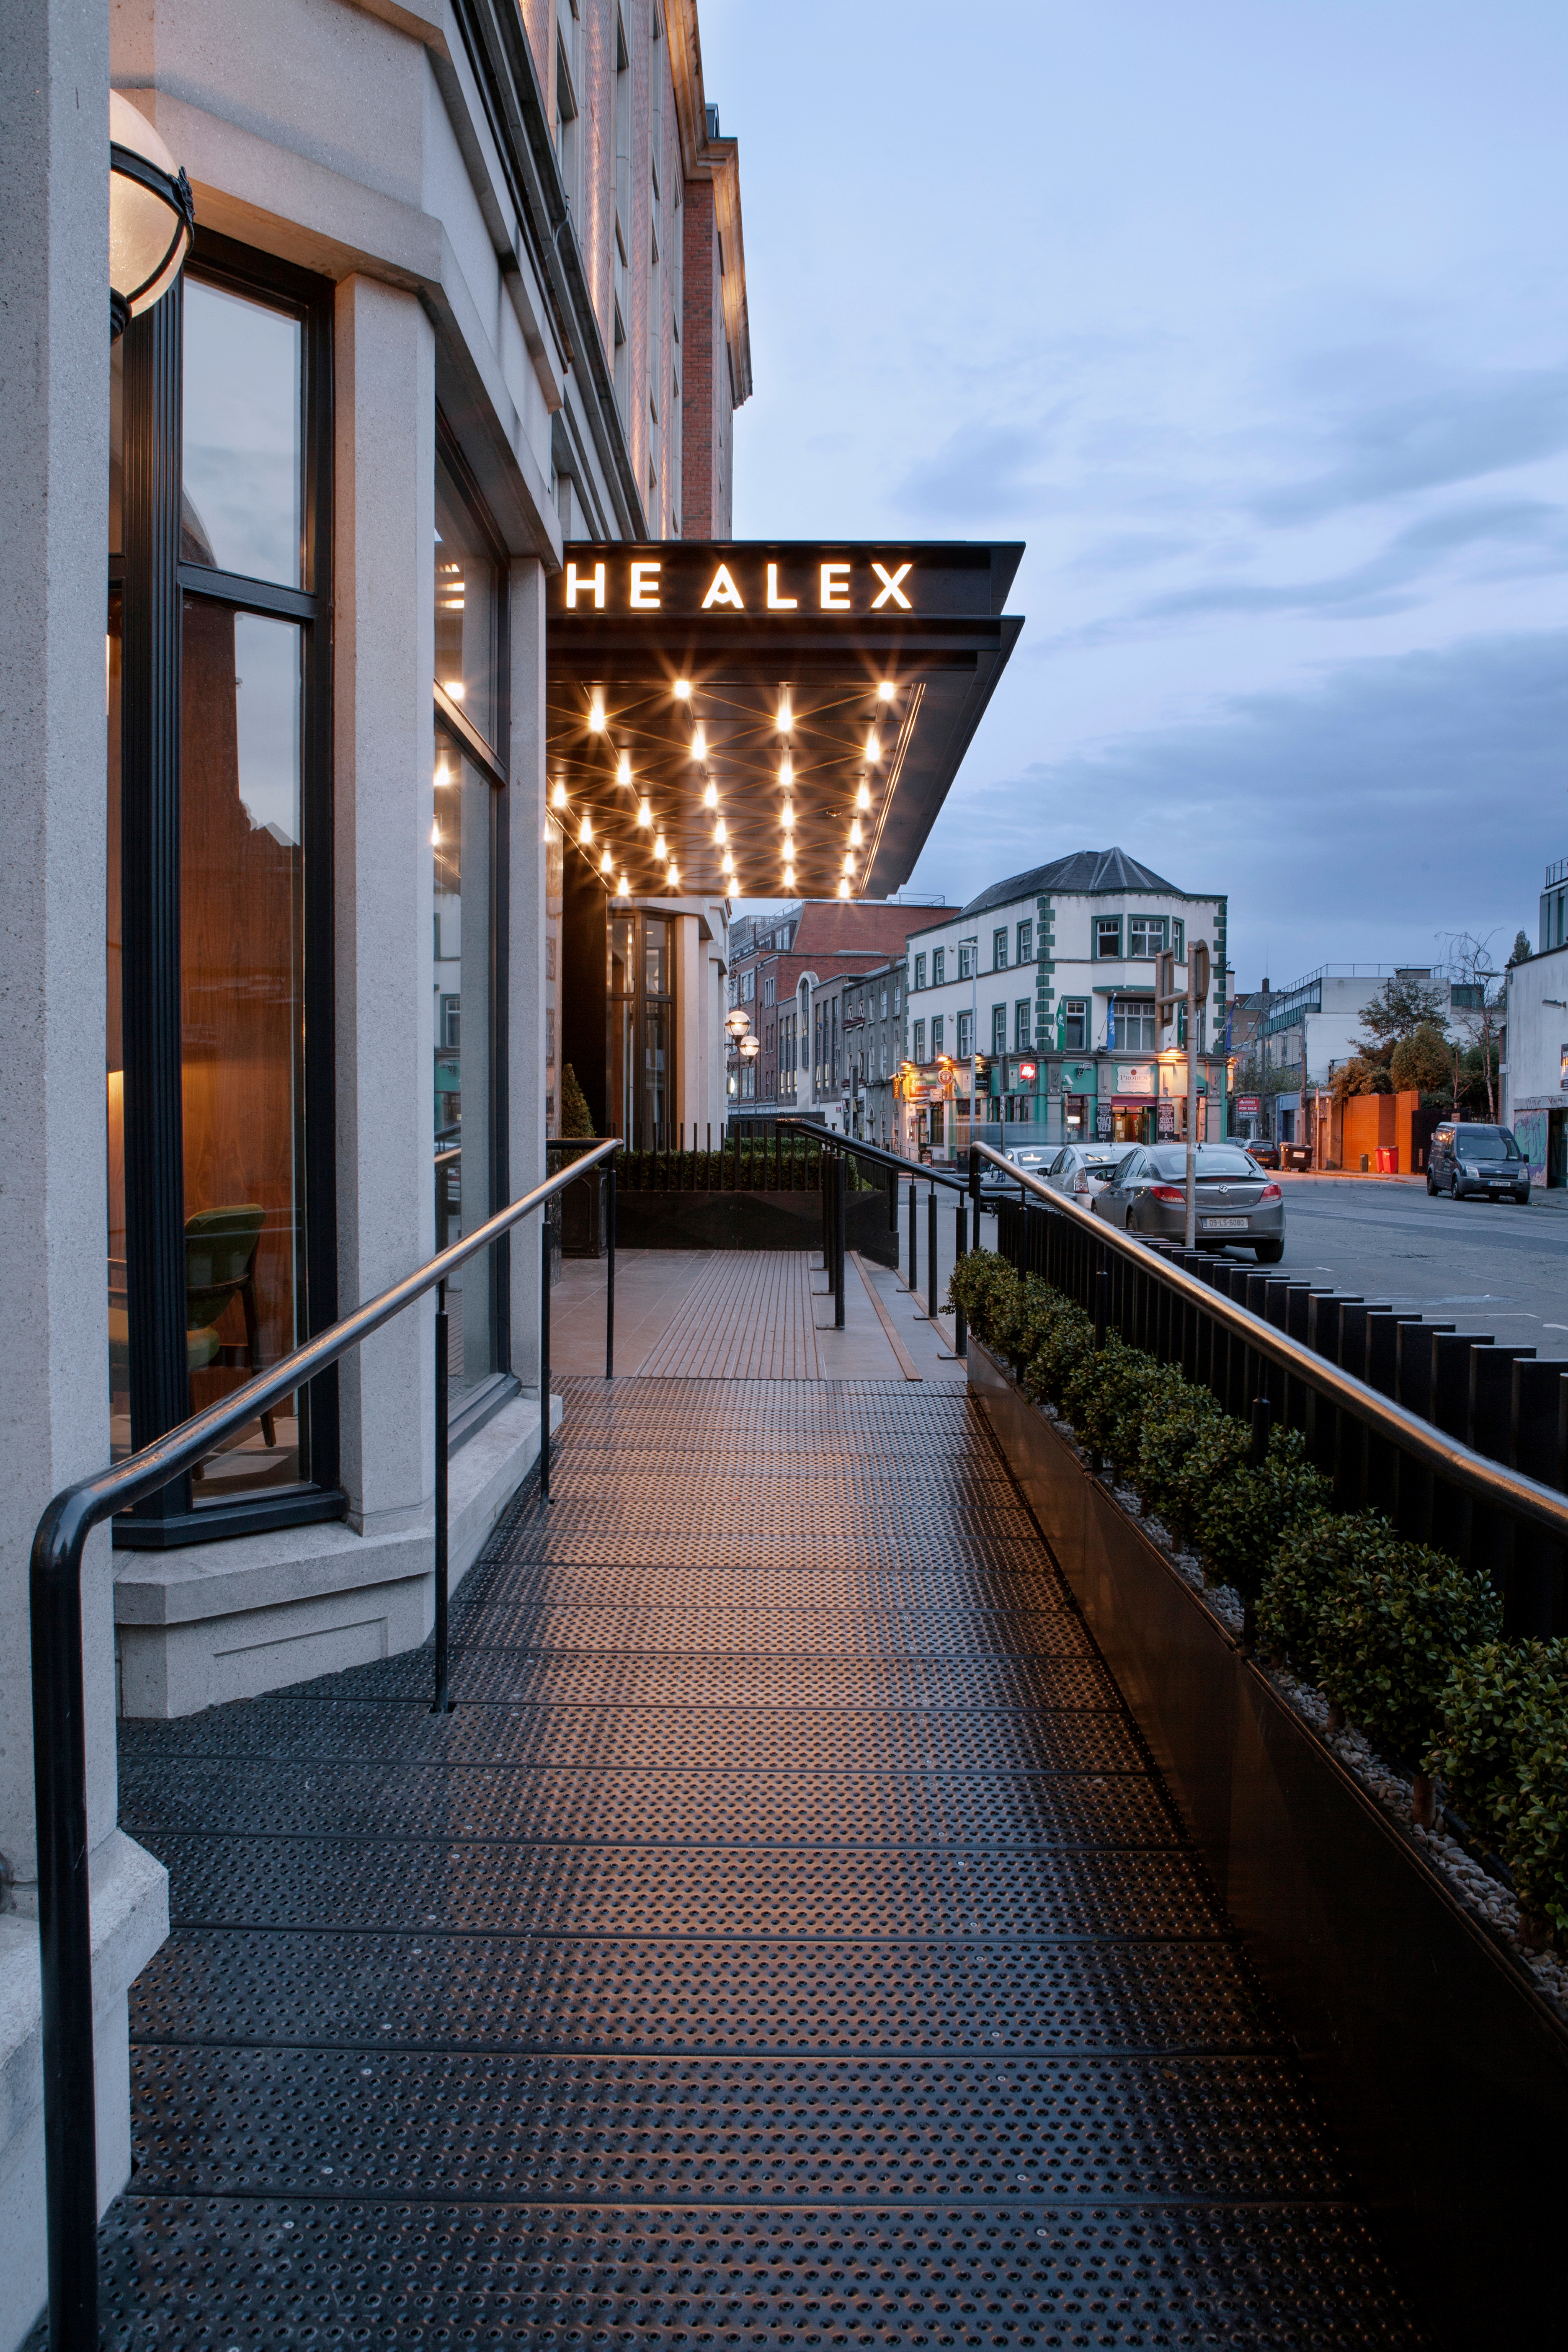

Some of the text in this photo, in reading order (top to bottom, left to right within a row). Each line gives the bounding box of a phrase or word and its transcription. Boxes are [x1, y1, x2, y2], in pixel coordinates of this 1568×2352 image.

[701, 563, 913, 609] ALEX
[1022, 1066, 1034, 1078] illy
[1096, 1116, 1112, 1124] CRAFT
[1098, 1124, 1112, 1132] BEER
